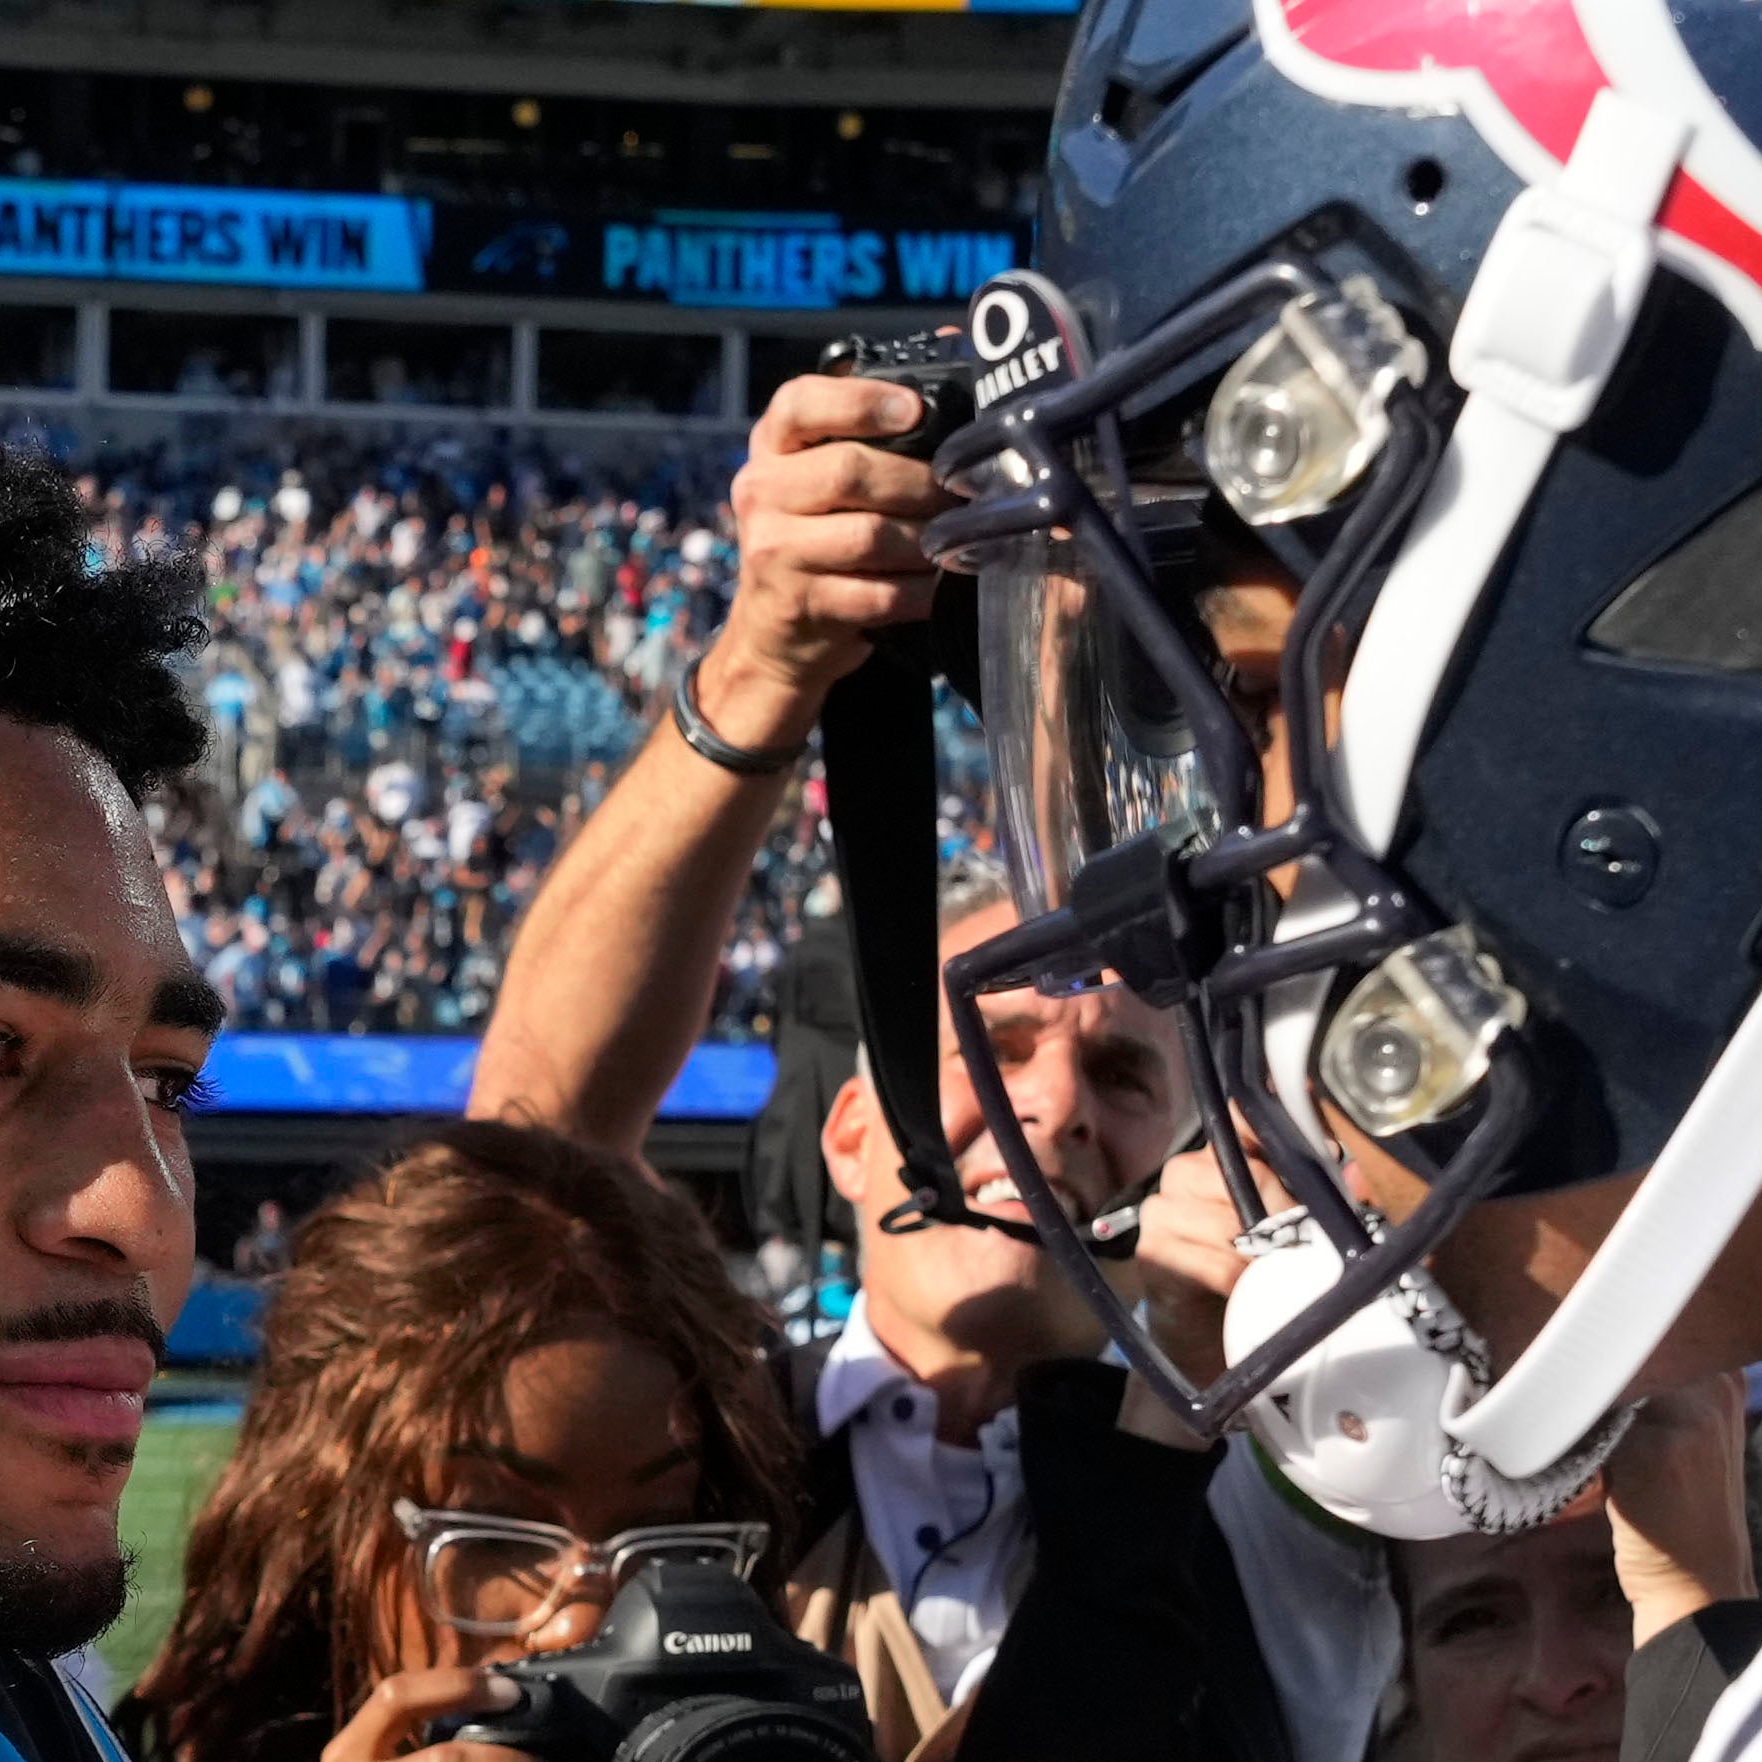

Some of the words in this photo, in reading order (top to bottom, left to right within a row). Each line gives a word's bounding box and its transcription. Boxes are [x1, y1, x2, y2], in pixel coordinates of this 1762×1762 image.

[262, 213, 371, 273] WIN
[602, 223, 888, 298] PANTHERS
[893, 230, 1017, 298] WIN
[663, 1630, 753, 1655] Canon
